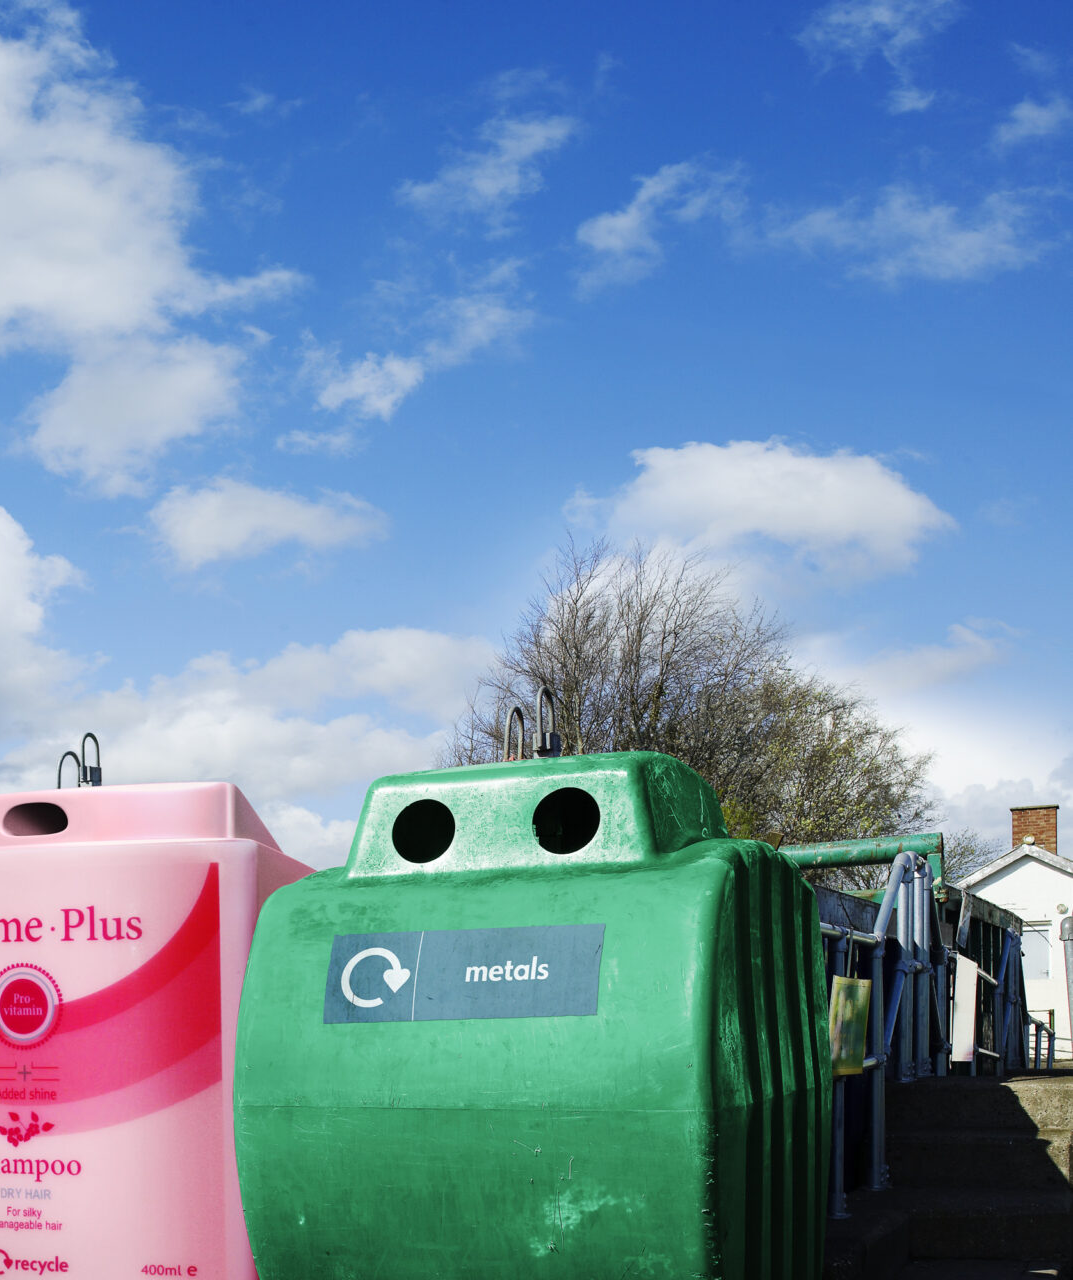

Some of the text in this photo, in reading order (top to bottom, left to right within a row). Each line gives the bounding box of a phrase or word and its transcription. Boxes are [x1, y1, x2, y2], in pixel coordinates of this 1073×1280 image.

[464, 956, 549, 983] metals
[3, 1004, 43, 1016] vitamin
[29, 1087, 57, 1101] shine
[0, 1187, 51, 1200] DRY HAIR
[6, 1206, 42, 1219] For silky
[45, 1221, 62, 1231] hair
[14, 1255, 69, 1275] recycle
[140, 1264, 182, 1276] 400ml
